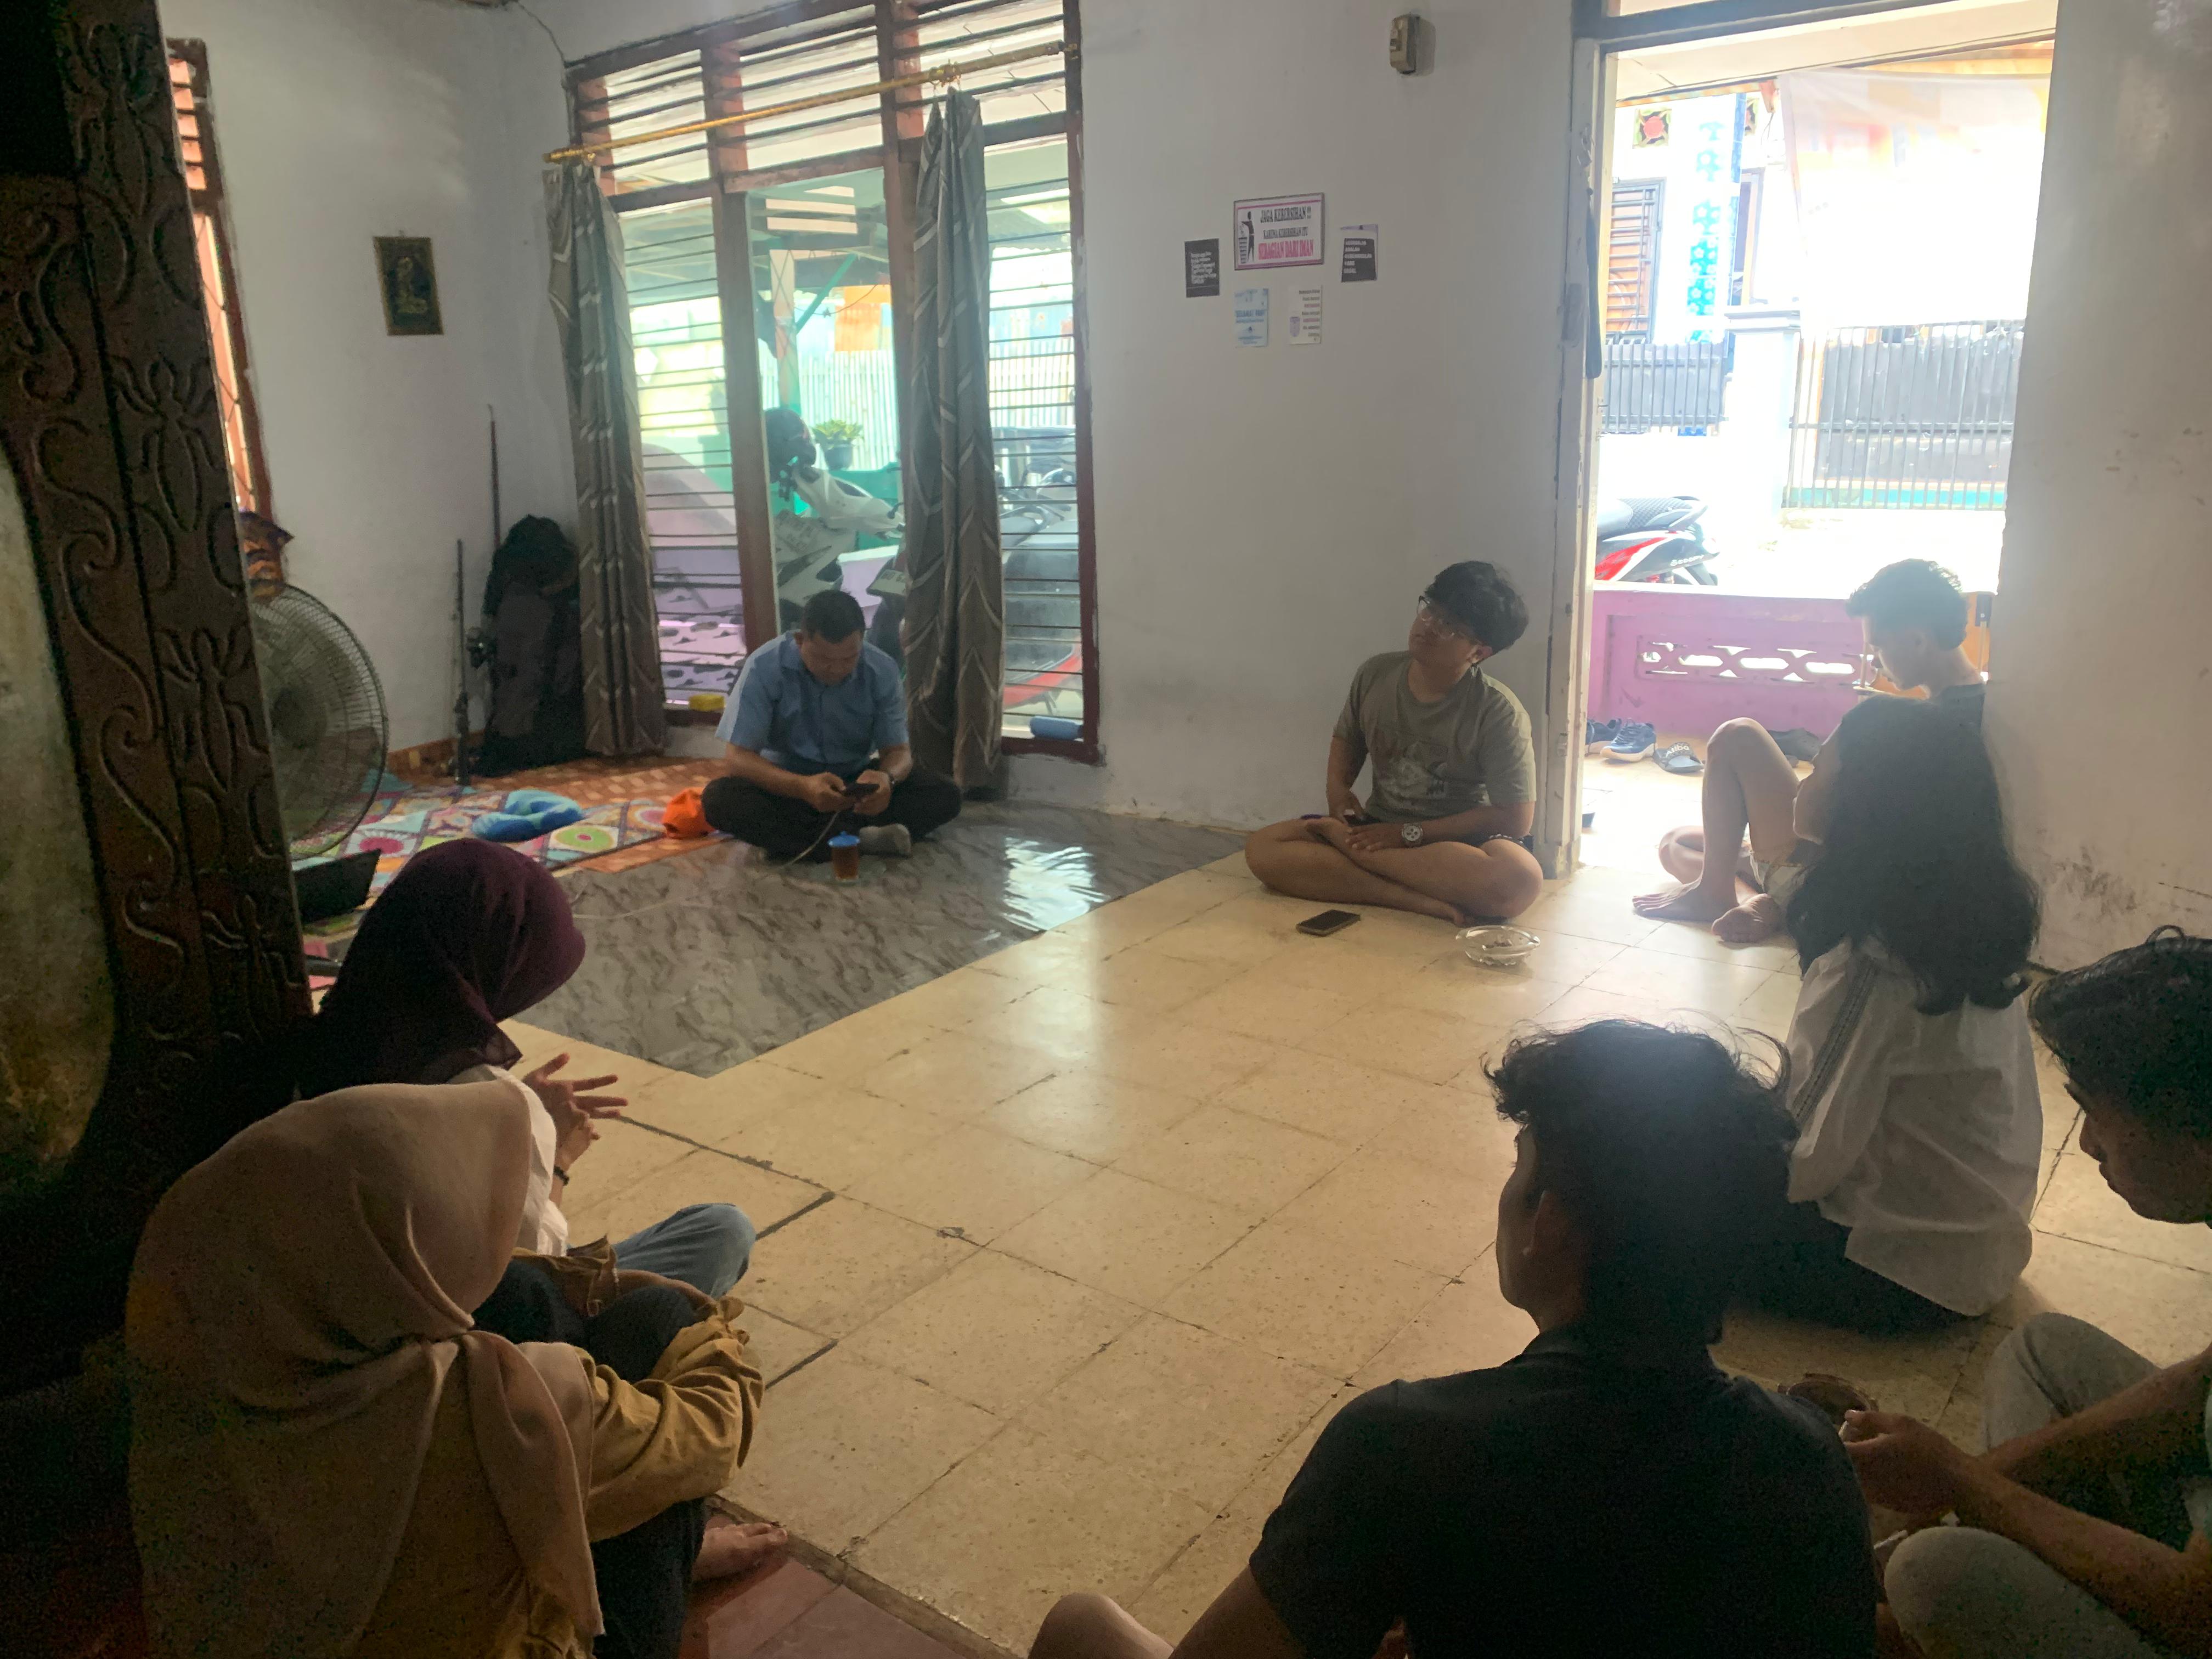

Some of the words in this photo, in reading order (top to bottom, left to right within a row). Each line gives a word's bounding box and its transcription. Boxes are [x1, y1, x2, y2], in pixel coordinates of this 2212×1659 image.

[1260, 209, 1273, 223] JAGA
[1274, 206, 1306, 222] KEBERSIHAN
[1285, 240, 1299, 258] DARI
[1299, 239, 1314, 257] IMAN
